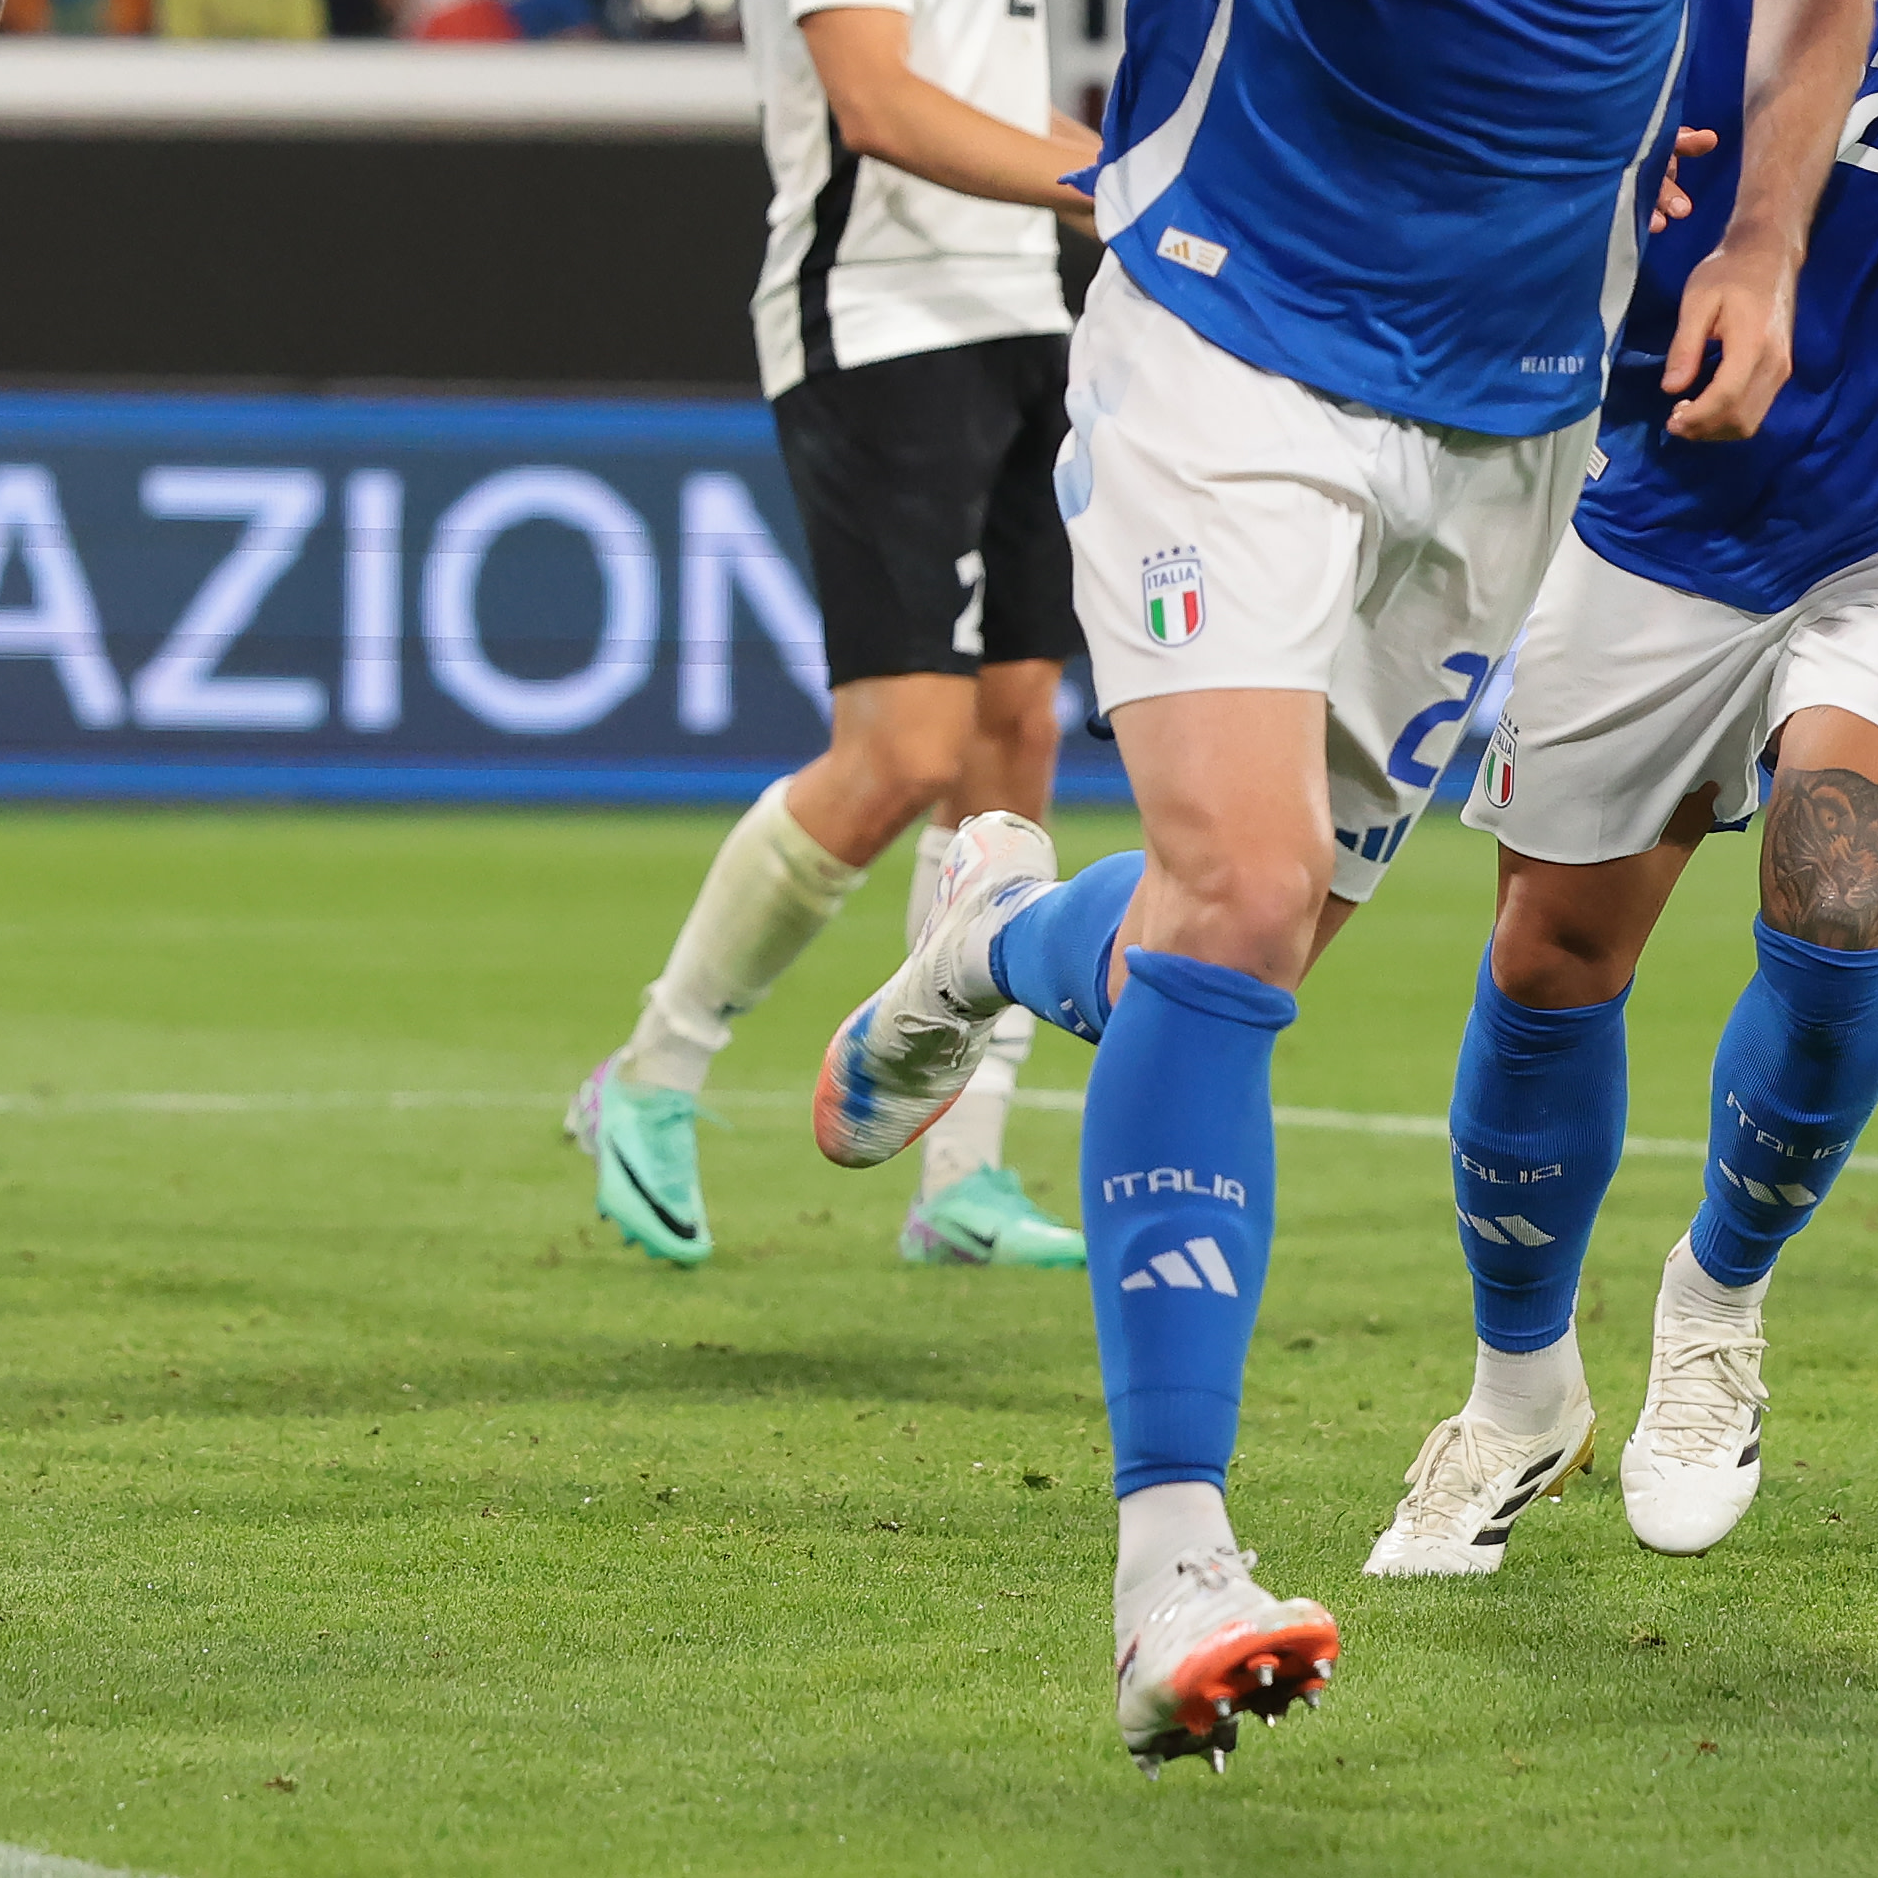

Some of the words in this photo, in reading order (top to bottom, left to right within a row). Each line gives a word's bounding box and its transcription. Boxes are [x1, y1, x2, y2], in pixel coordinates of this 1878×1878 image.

[1147, 565, 1196, 590] ITALIA
[1388, 651, 1490, 790] 2
[1450, 1132, 1563, 1184] TALIA
[1103, 1167, 1246, 1210] ITALIA
